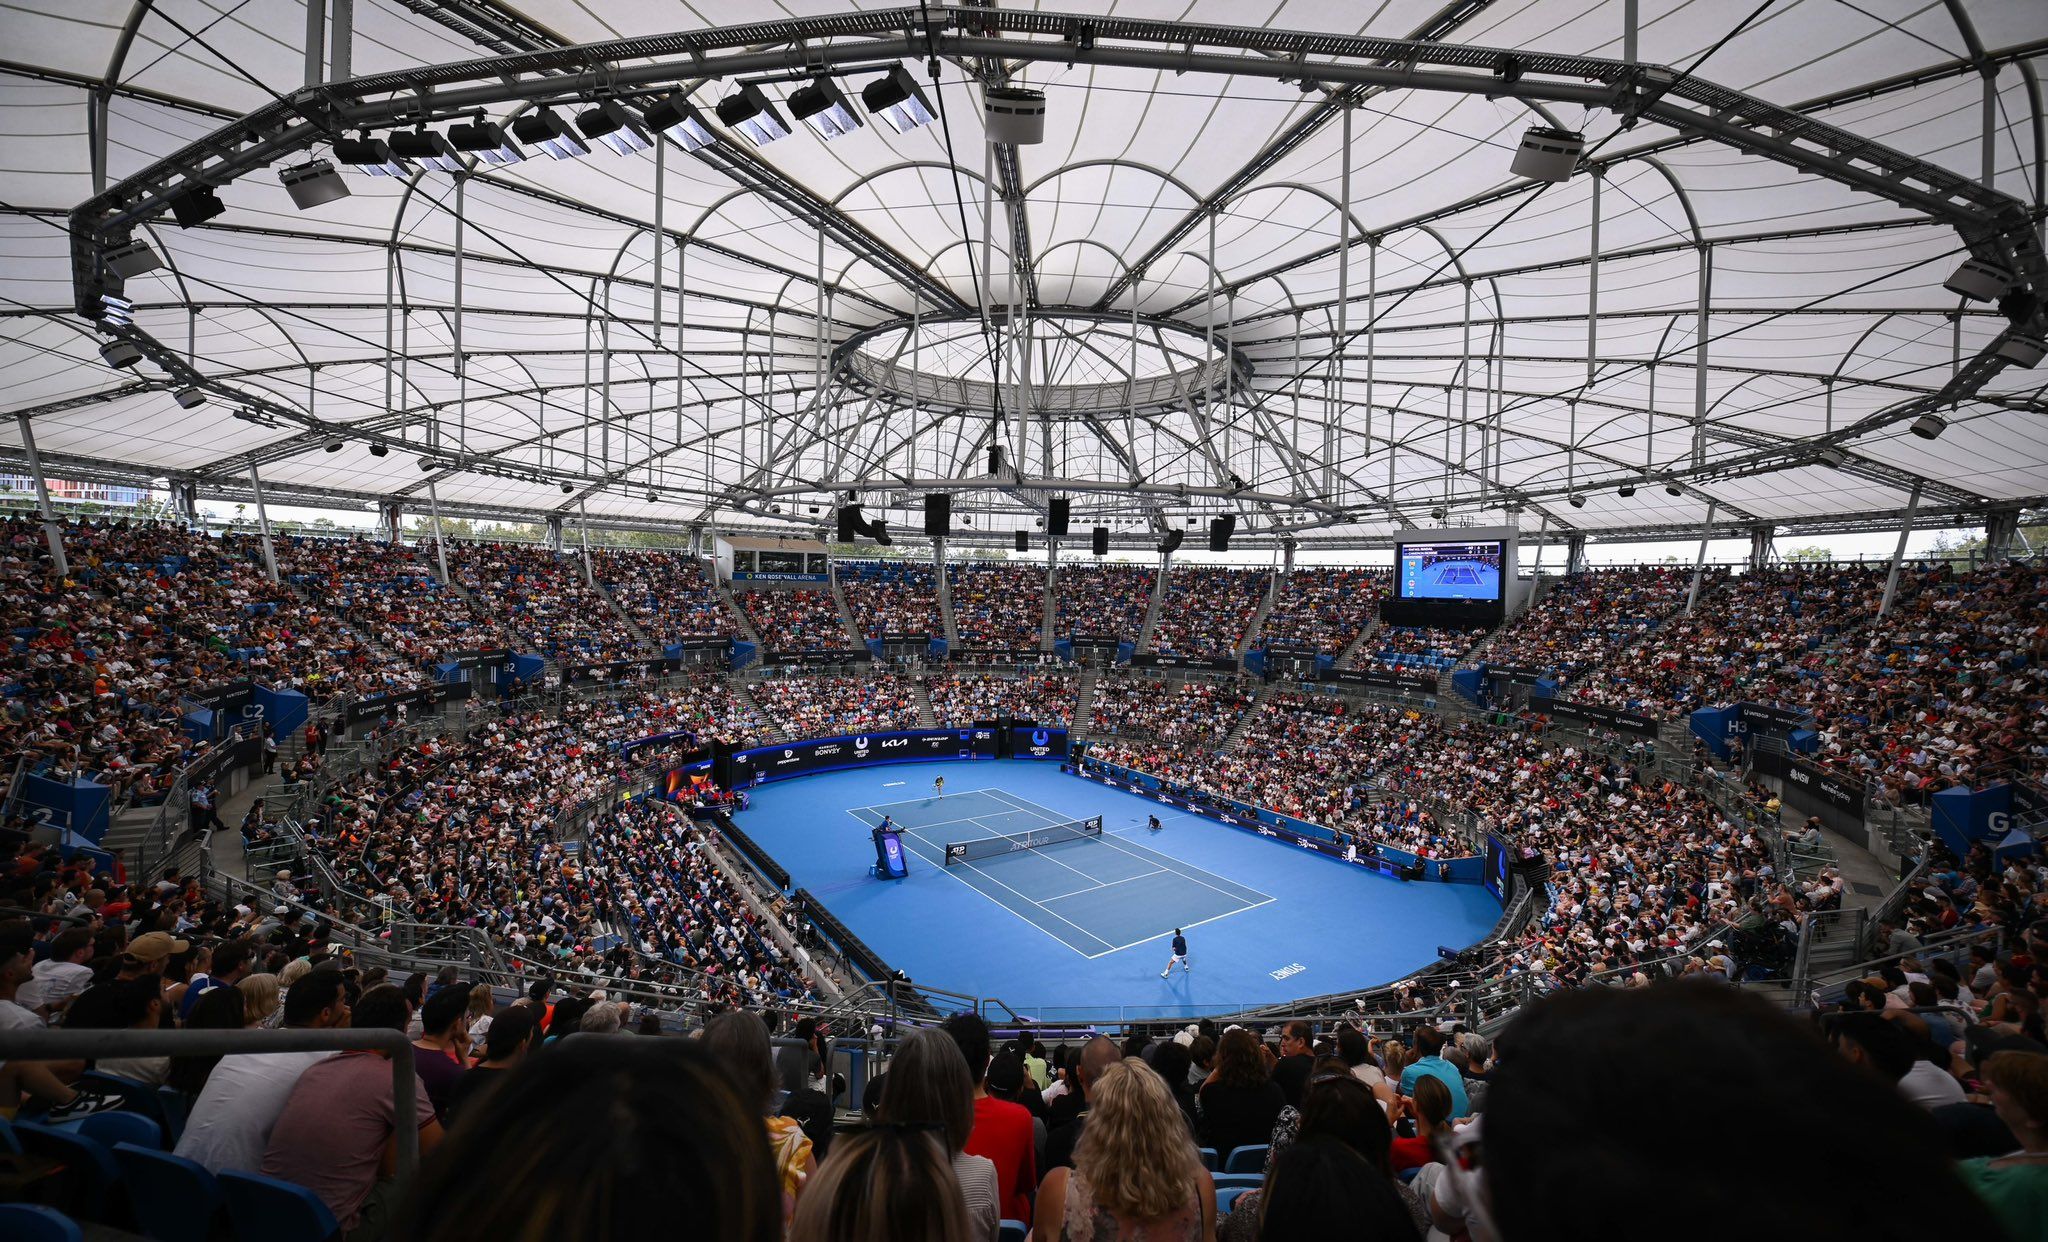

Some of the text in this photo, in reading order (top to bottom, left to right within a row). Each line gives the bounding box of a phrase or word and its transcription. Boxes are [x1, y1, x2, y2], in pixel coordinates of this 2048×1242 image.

[504, 662, 515, 672] B2
[242, 704, 264, 719] C2
[1728, 720, 1747, 732] H3
[1269, 963, 1306, 980] SYDNEY
